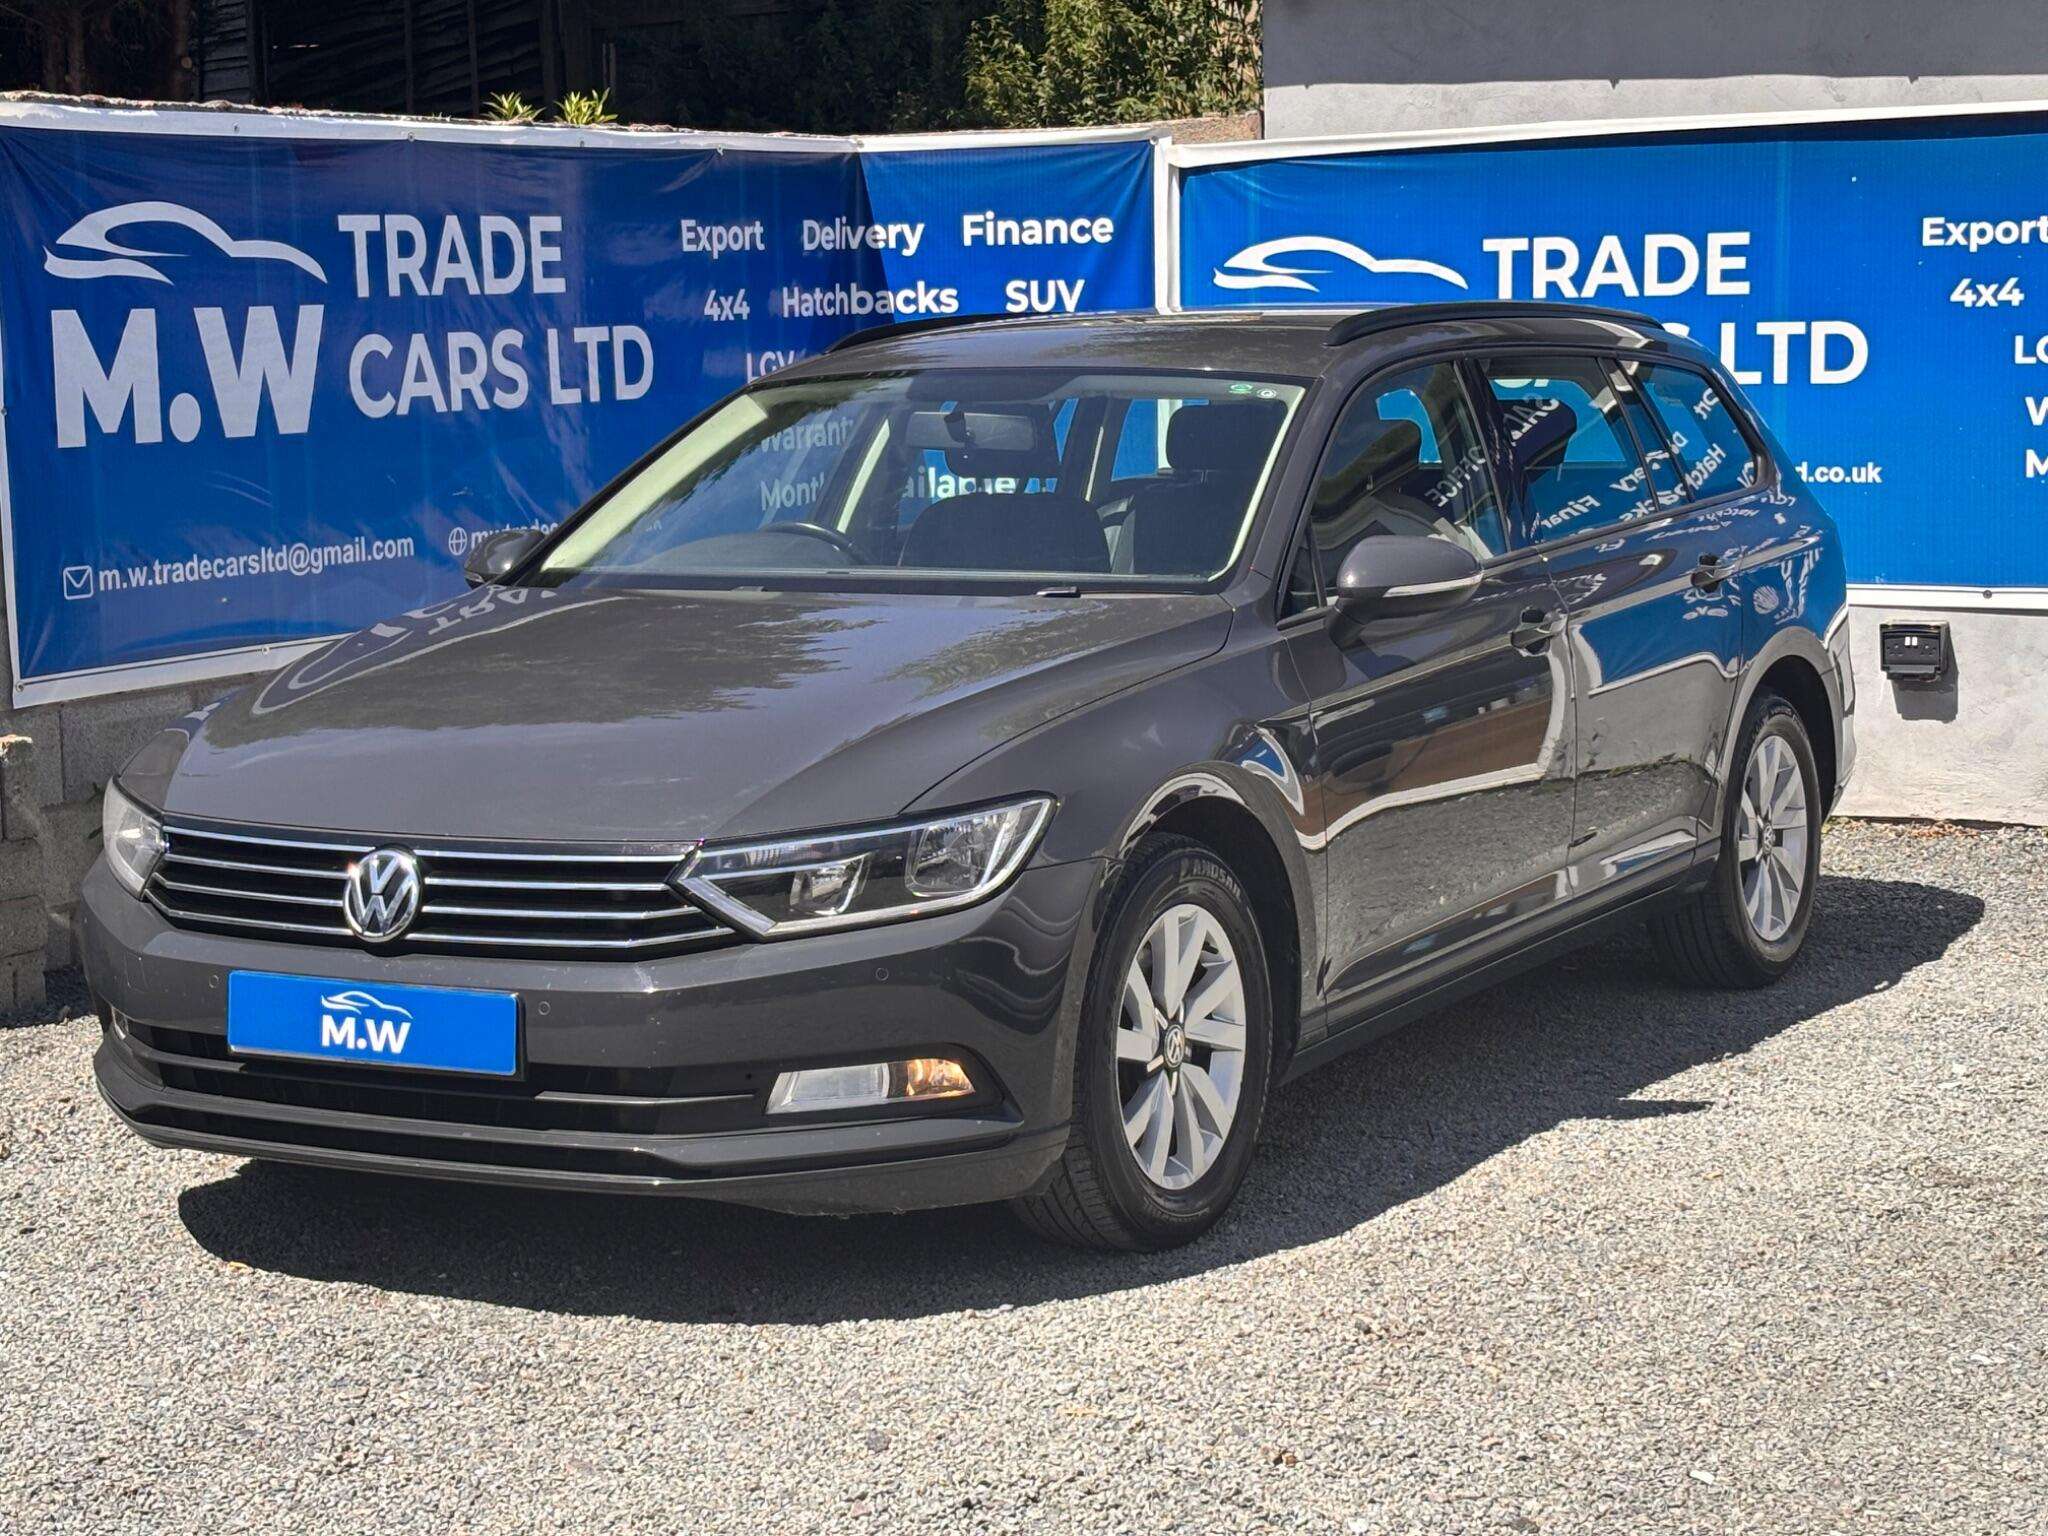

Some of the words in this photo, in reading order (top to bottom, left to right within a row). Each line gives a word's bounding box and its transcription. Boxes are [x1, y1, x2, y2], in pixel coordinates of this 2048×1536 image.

[338, 214, 566, 297] TRADE
[681, 219, 765, 259] Export
[803, 216, 924, 257] Delivery
[962, 211, 1114, 247] Finance
[1482, 232, 1750, 300] TRADE
[1950, 277, 2025, 307] 4x4
[704, 288, 750, 321] 4x4
[782, 282, 960, 319] Hatchbacks
[1005, 279, 1085, 313] SUV
[51, 303, 325, 448] M.W
[348, 328, 529, 419] CARS
[548, 324, 654, 404] LTD
[1720, 321, 1869, 385] LTD
[99, 536, 415, 592] m.w.tradecarsltd@gmail.com
[321, 1013, 412, 1055] M.W
